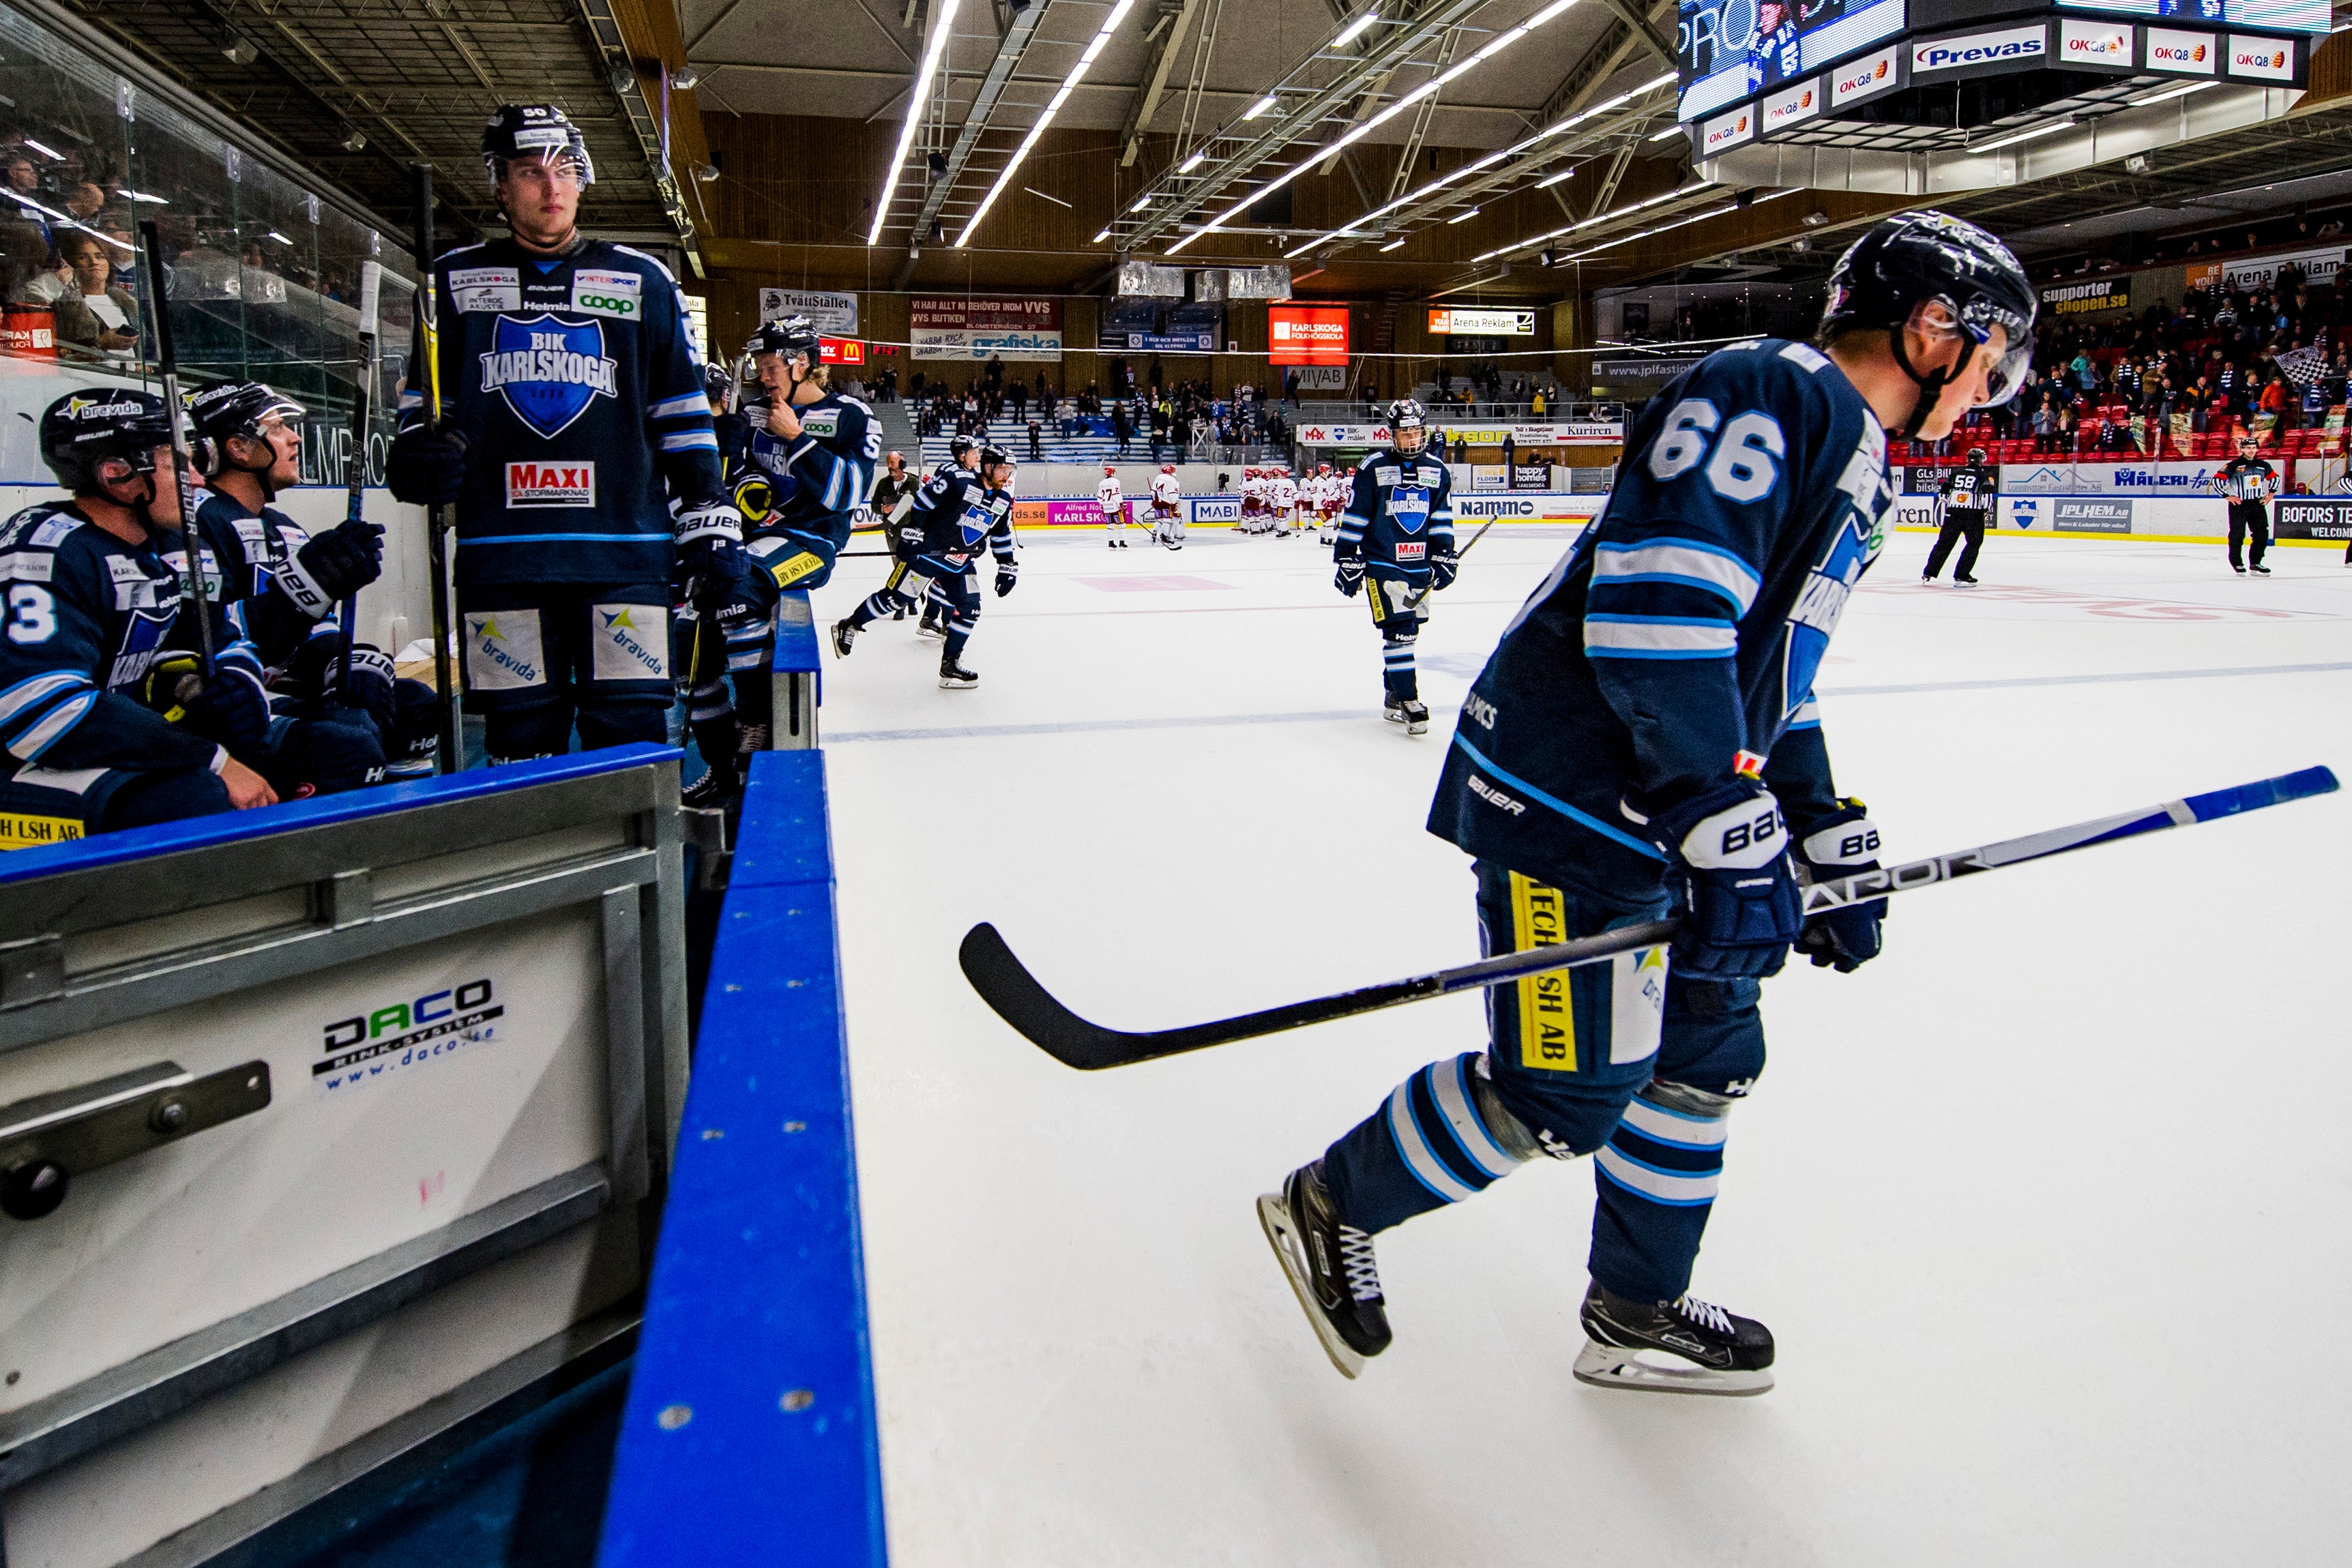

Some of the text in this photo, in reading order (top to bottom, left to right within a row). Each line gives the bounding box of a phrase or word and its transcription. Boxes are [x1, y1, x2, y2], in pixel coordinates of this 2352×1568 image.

[1929, 39, 2042, 66] Prevas
[523, 108, 548, 117] 50
[2207, 265, 2219, 276] BE
[2226, 268, 2272, 284] Arena
[452, 276, 516, 286] KARLSKOGA
[585, 276, 637, 286] INTERSPORT
[2194, 277, 2214, 287] YOU
[2042, 280, 2112, 303] supporter
[524, 301, 570, 311] Helmia
[580, 295, 634, 314] coop
[784, 294, 849, 309] TvättStället
[912, 301, 1050, 314] VI HAR ALLT NI BEHÖVER INOM VVS
[2056, 293, 2128, 314] shopen.se
[912, 314, 929, 323] VVS
[932, 314, 965, 323] BUTIKEN
[1454, 318, 1514, 328] Arena Reklam
[1291, 323, 1344, 332] KARLSKOGA
[530, 332, 568, 351] BIK
[1291, 331, 1344, 340] FOLKHÖGSKOLA
[915, 347, 942, 356] SNABBA
[972, 334, 1059, 357] grafiska
[484, 351, 614, 392] KARLSKOGA
[194, 385, 239, 405] bravida
[83, 401, 143, 418] bravida
[804, 423, 833, 434] coop
[1306, 427, 1325, 440] MAX
[1430, 428, 1512, 443] kson
[1568, 426, 1611, 435] Kuriren
[1648, 398, 1788, 505] 66
[510, 464, 589, 489] MAXI
[1515, 466, 1544, 476] happy
[1916, 469, 1934, 478] GLs
[933, 475, 948, 494] 3
[1954, 475, 1977, 488] 58
[525, 489, 589, 497] STORMARKNAD
[179, 471, 199, 535] BAUER
[1461, 501, 1533, 516] Nammo
[1201, 506, 1237, 517] MABI
[2282, 507, 2333, 523] BOFORS
[676, 516, 741, 537] BAUER
[1398, 544, 1424, 554] MAXI
[0, 583, 58, 645] 3
[482, 638, 537, 681] bravida
[613, 629, 663, 675] bravida
[18, 820, 51, 840] LSH
[1802, 847, 1997, 917] APOR
[1537, 975, 1563, 1014] SH
[323, 979, 493, 1053] DACO
[1539, 1023, 1567, 1061] AB
